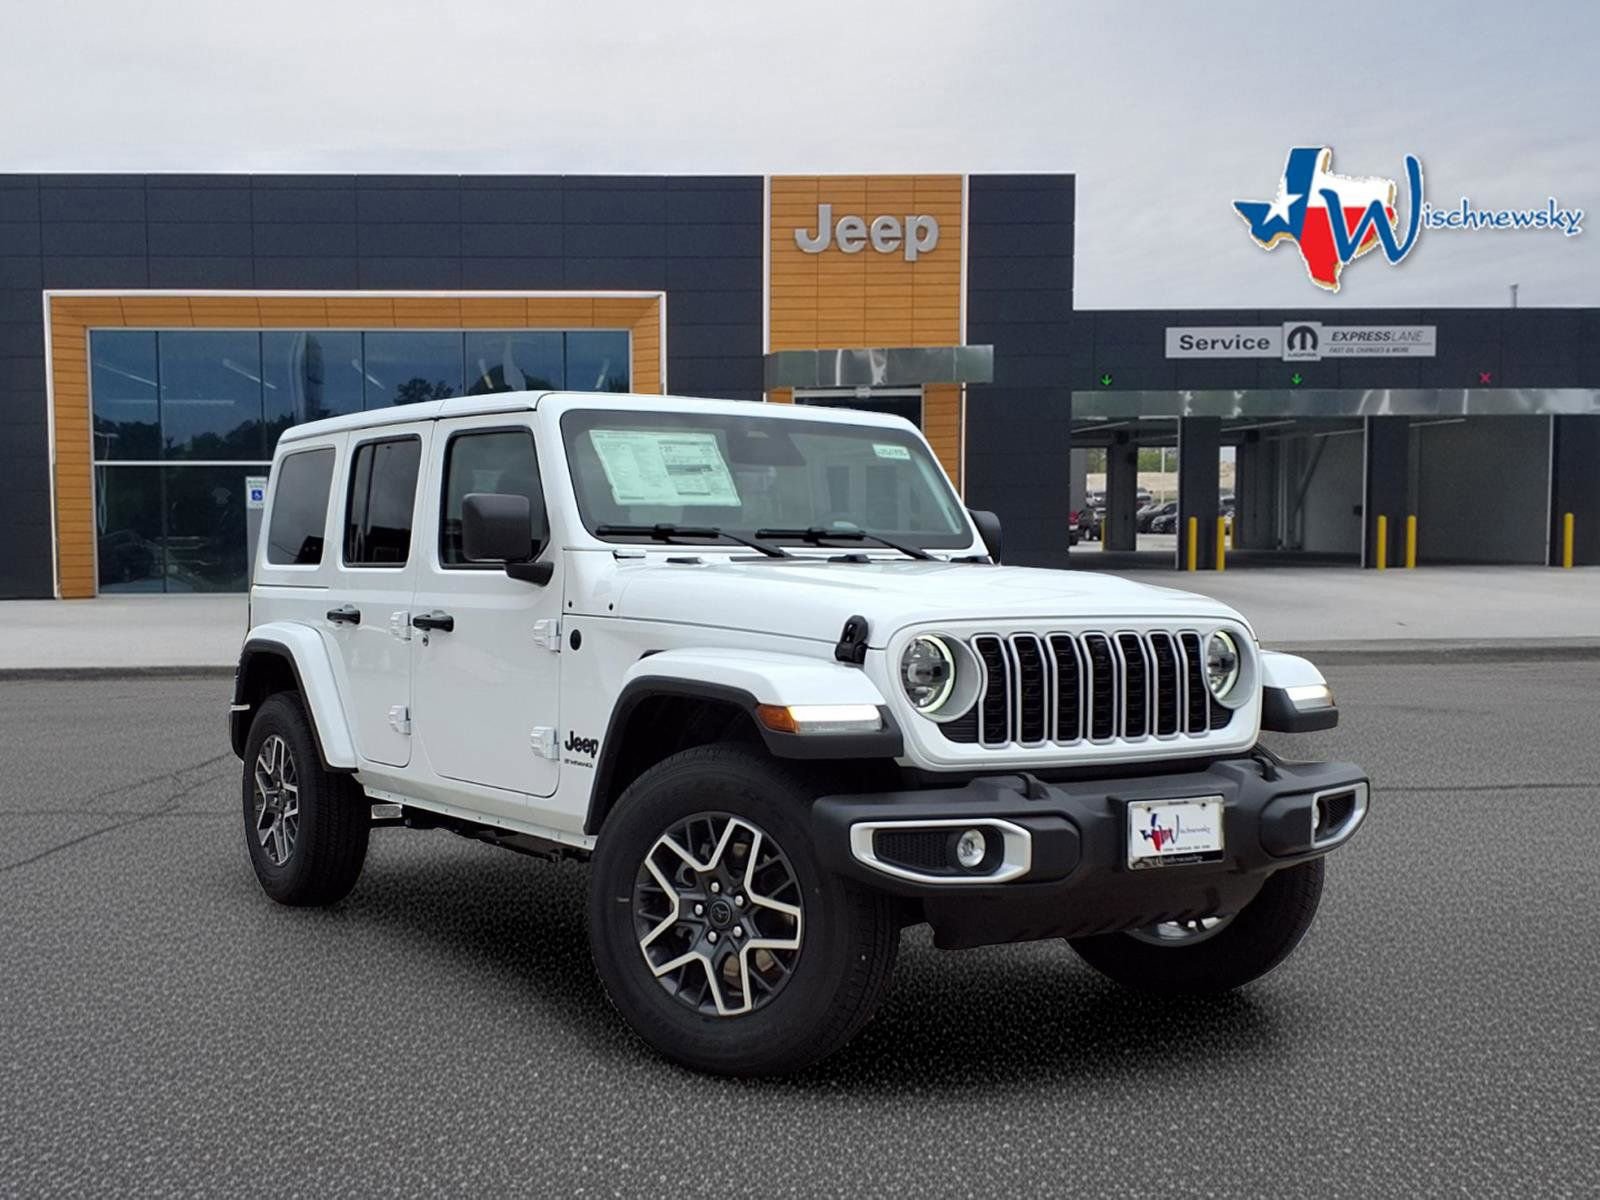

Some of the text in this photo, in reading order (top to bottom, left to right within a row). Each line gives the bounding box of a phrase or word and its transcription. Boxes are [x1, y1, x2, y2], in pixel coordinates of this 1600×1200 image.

[795, 204, 938, 261] Jeep
[1179, 334, 1270, 350] Service
[565, 731, 599, 758] Jeep
